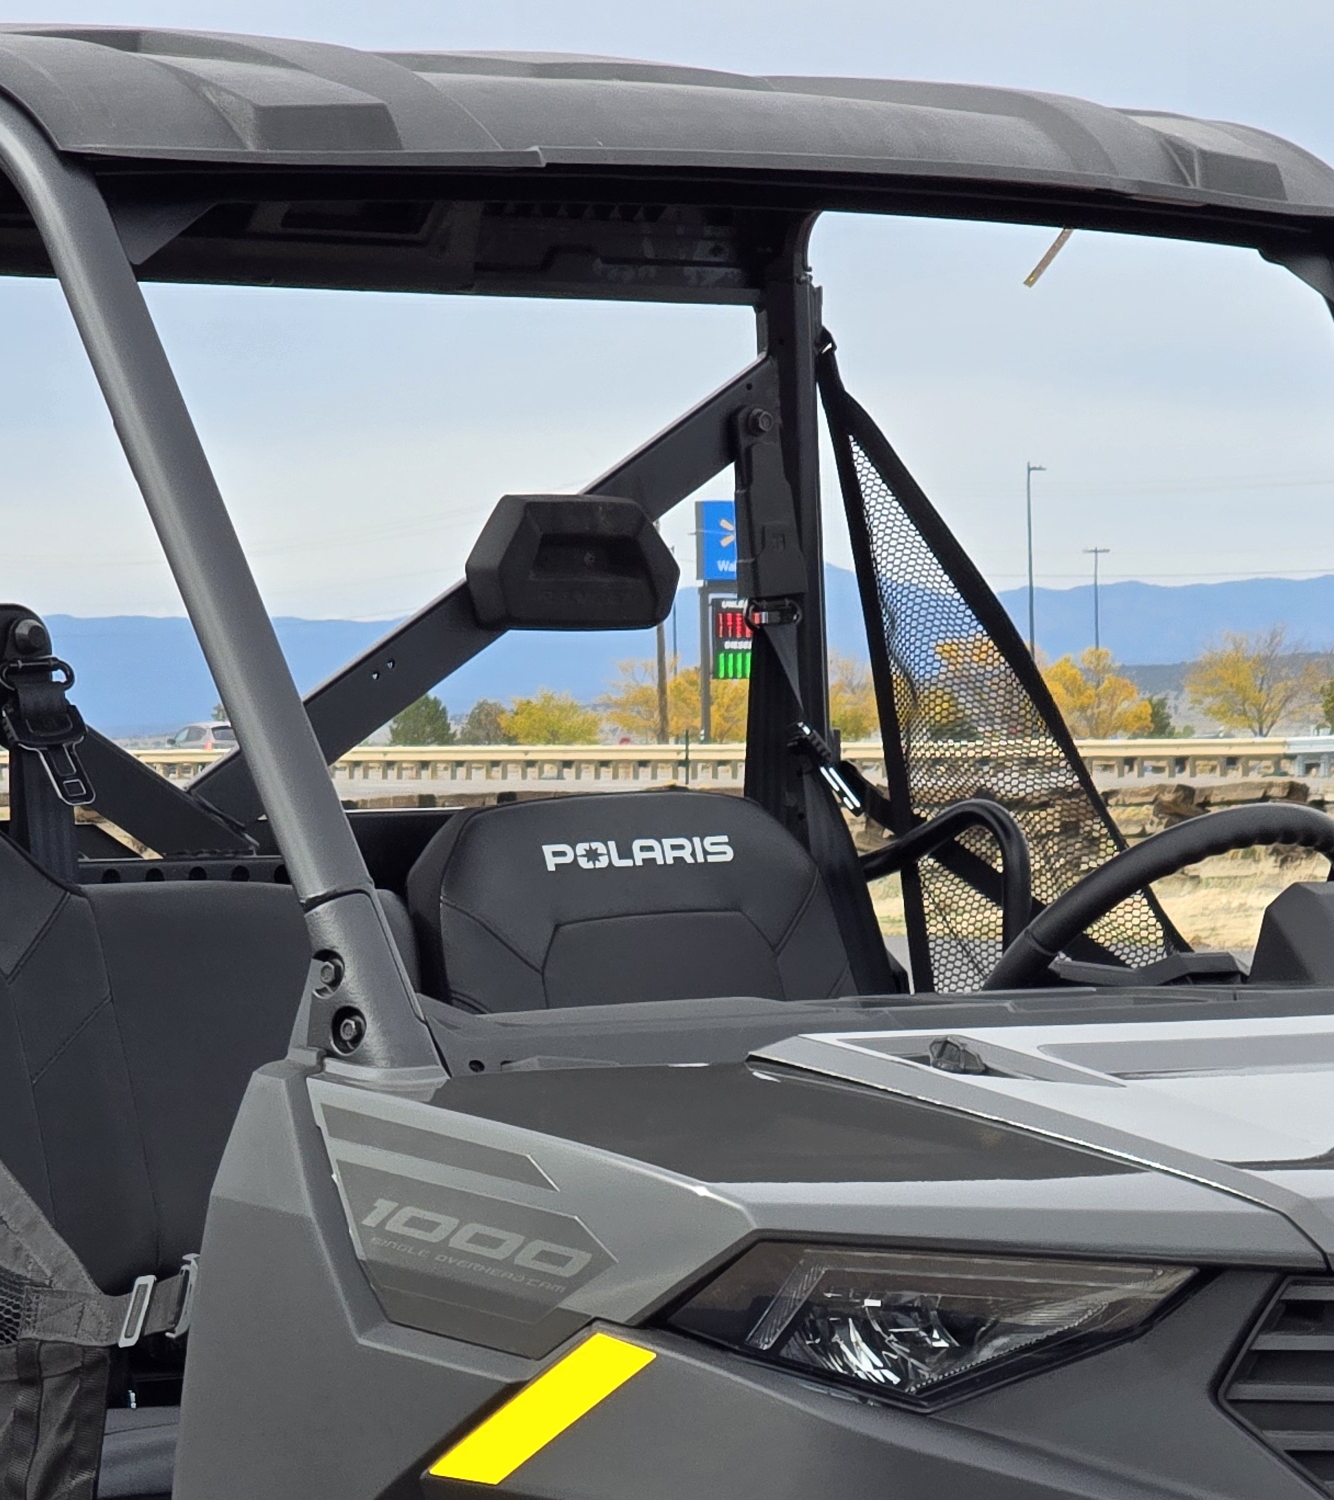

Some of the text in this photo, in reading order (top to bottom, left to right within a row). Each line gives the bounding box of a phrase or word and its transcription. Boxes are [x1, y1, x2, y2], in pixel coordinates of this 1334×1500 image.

[542, 835, 734, 871] POLARIS
[361, 1198, 593, 1278] 1000
[370, 1237, 567, 1294] SINGLE OVERHEAD CAM
